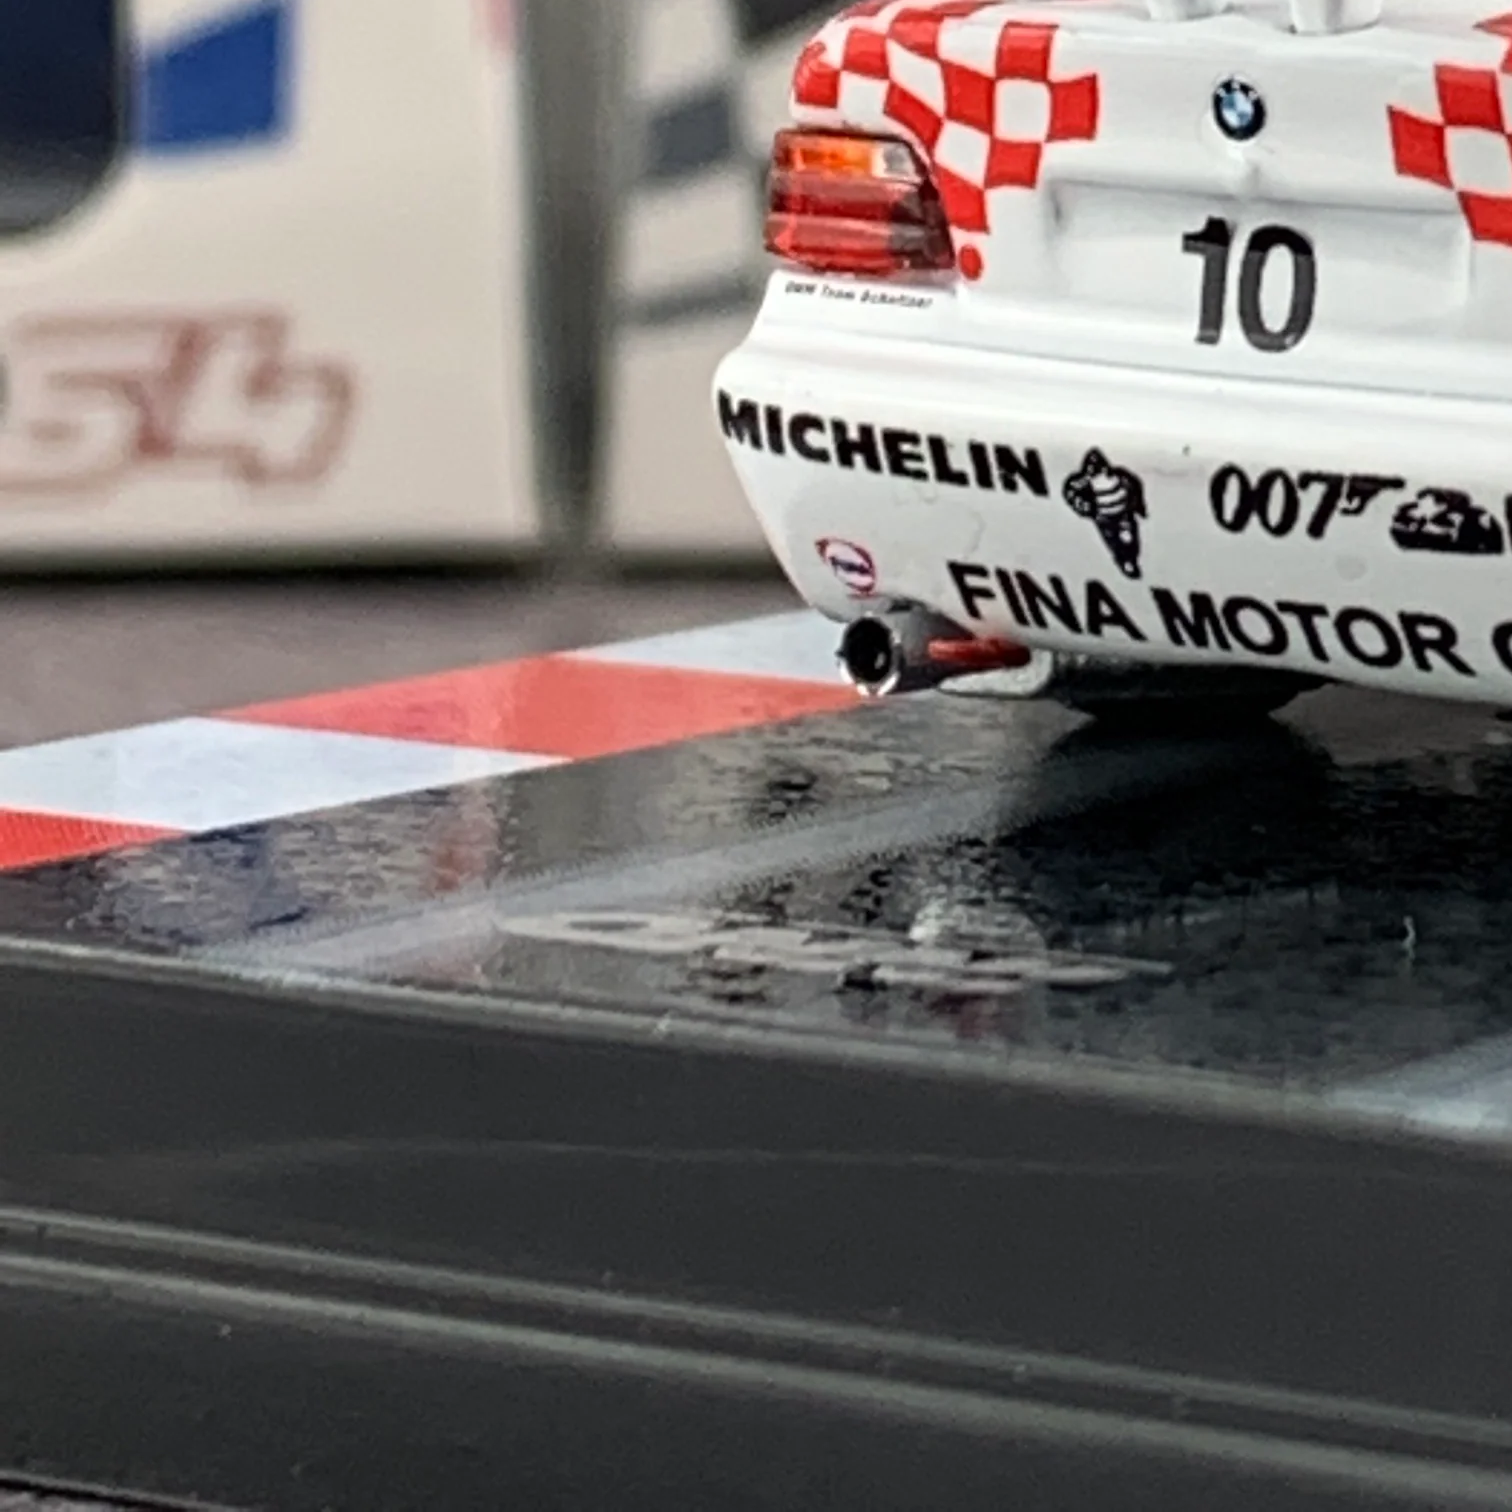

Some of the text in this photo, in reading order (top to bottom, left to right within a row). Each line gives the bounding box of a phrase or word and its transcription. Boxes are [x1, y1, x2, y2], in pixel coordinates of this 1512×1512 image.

[1182, 214, 1318, 354] 10
[717, 388, 1050, 498] MICHELIN
[1209, 462, 1352, 540] 007
[947, 561, 1147, 642] FINA
[1149, 586, 1478, 677] MOTOR
